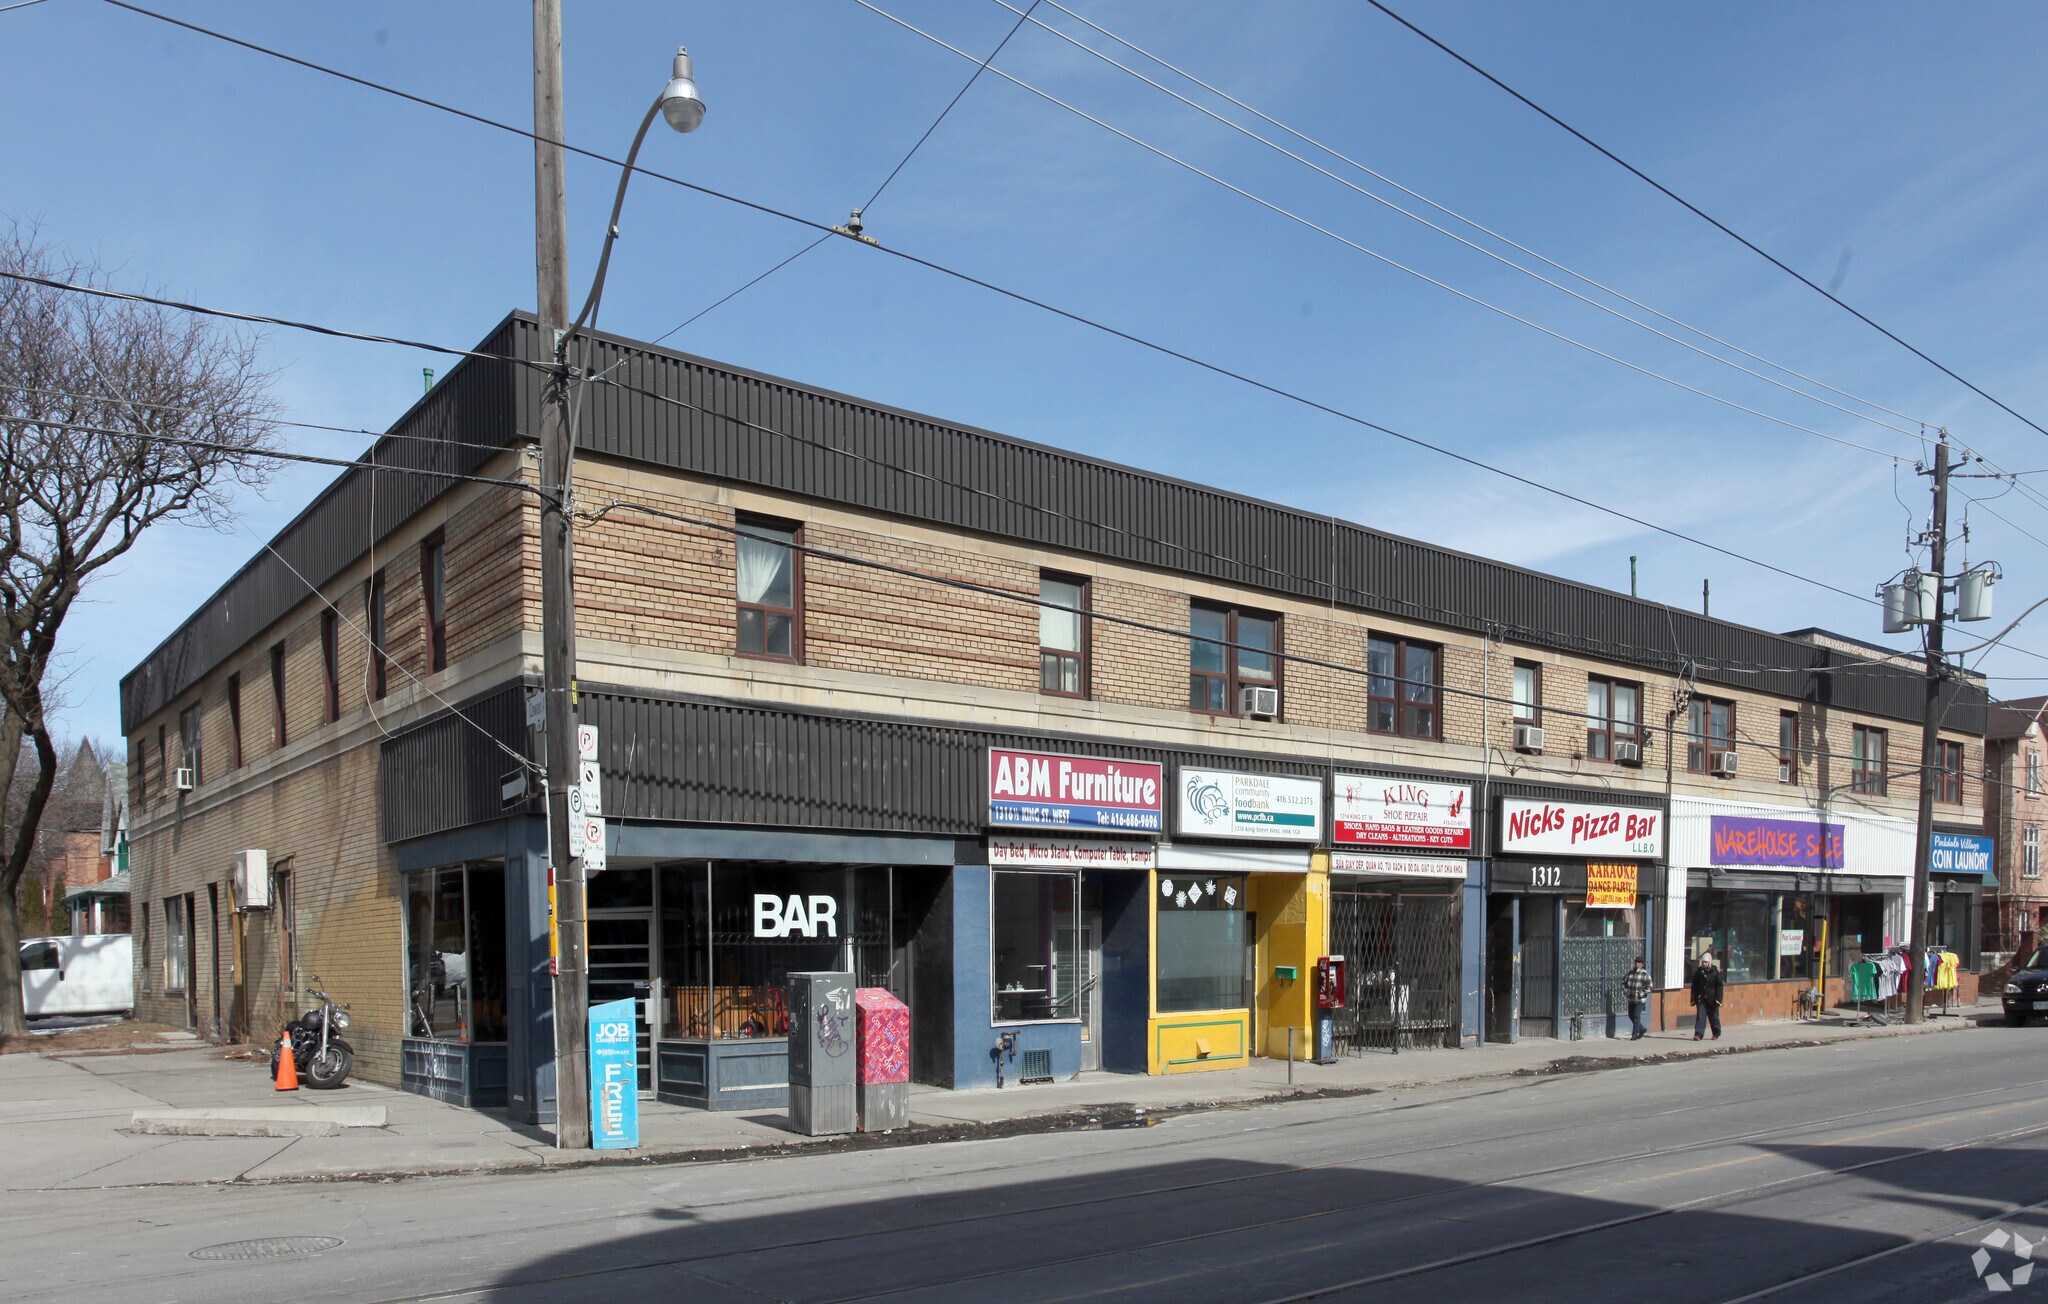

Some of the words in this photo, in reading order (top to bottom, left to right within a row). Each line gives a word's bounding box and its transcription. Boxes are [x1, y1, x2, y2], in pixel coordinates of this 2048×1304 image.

[994, 755, 1052, 798] ABM
[1059, 761, 1156, 805] Furniture
[1235, 776, 1270, 789] PARKDALE
[1235, 787, 1270, 798] community
[1276, 795, 1314, 806] 416.532.2375
[1383, 784, 1429, 809] KING
[1235, 797, 1270, 810] foodbank
[1021, 807, 1040, 822] KING
[1041, 808, 1051, 823] ST.
[1052, 808, 1070, 824] WEST
[1096, 811, 1109, 826] Tel:
[1110, 812, 1158, 829] 416-686-9696
[1237, 812, 1274, 823] www.pcfb.ca
[1383, 809, 1403, 820] SHOE
[1404, 811, 1429, 822] REPAIR
[1245, 826, 1256, 834] King
[1343, 821, 1364, 831] SHOES,
[1364, 823, 1380, 831] HAND
[1380, 824, 1395, 832] BAGS
[1402, 825, 1425, 834] LEATHER
[1425, 827, 1444, 835] GOODS
[1444, 828, 1464, 836] REPAIRS
[1508, 804, 1565, 842] Nicks
[1570, 811, 1621, 845] Pizza
[1625, 813, 1656, 843] Bar
[1355, 831, 1367, 839] DRY
[1367, 832, 1389, 841] CLEANS
[1392, 833, 1426, 843] ALTERATIONS
[1440, 836, 1454, 844] CUTS
[1715, 824, 1800, 860] WAREHOUSE
[1806, 834, 1844, 859] SALE
[1934, 835, 1960, 848] Parkdale
[1960, 838, 1980, 853] Village
[993, 841, 1008, 861] Day
[1009, 841, 1027, 861] Bed,
[1028, 842, 1049, 859] Micro
[1050, 843, 1072, 862] Stand,
[1074, 844, 1107, 863] Computer
[1108, 845, 1129, 864] Table,
[1130, 847, 1152, 865] Lamps
[1632, 842, 1655, 854] L.L.B.O
[1932, 849, 1953, 869] COIN
[1954, 850, 1989, 870] LAUNDRY
[1531, 866, 1561, 887] 1312
[1588, 862, 1636, 880] KARAOKE
[1588, 880, 1611, 893] DANCE
[754, 894, 837, 938] BAR
[595, 1023, 630, 1038] JOB
[604, 1063, 624, 1136] FREE
